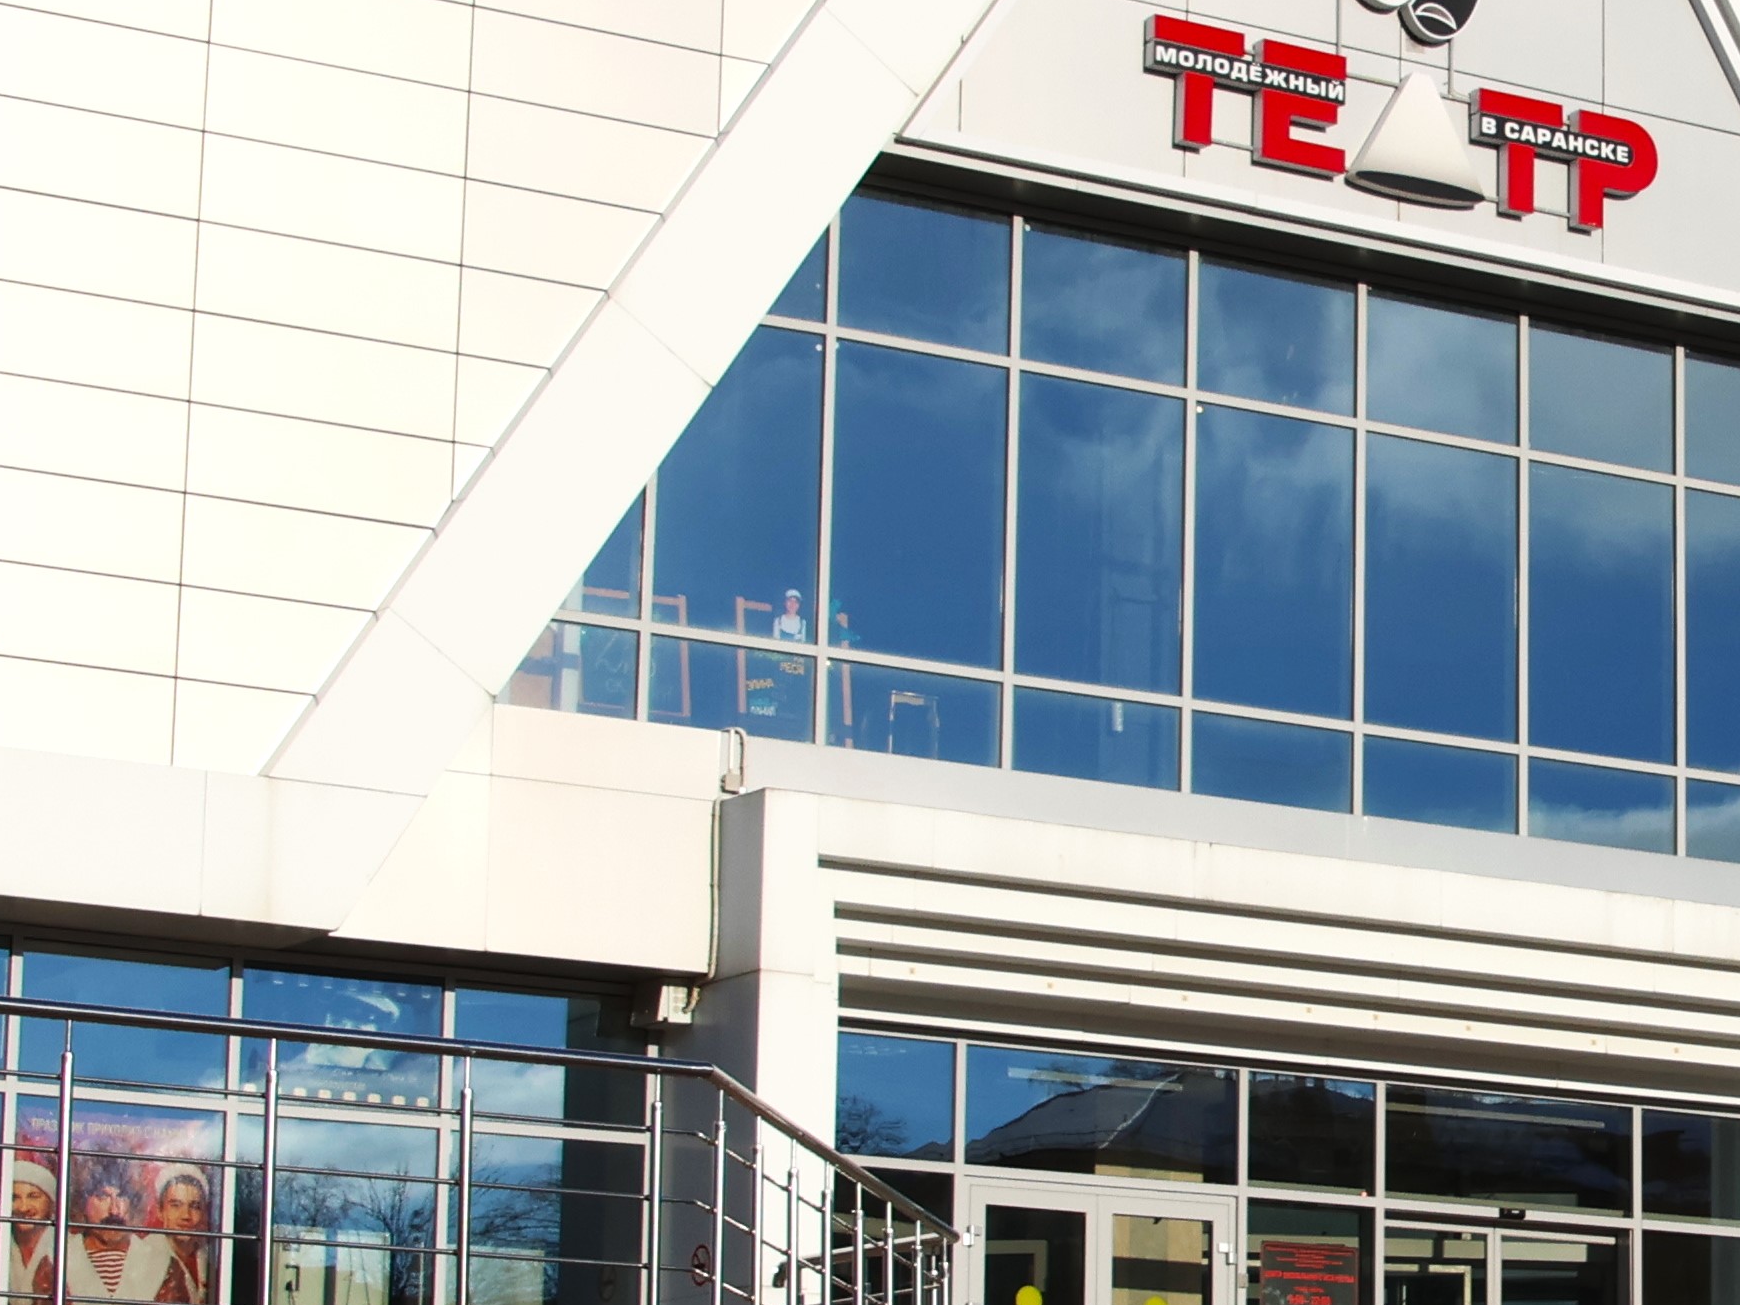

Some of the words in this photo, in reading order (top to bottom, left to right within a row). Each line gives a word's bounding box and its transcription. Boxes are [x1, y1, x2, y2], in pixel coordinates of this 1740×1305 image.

[1154, 43, 1345, 103] МОЛОДЁЖНЫЙ
[1480, 115, 1497, 136] В
[1503, 120, 1630, 165] САРАНСКЕ
